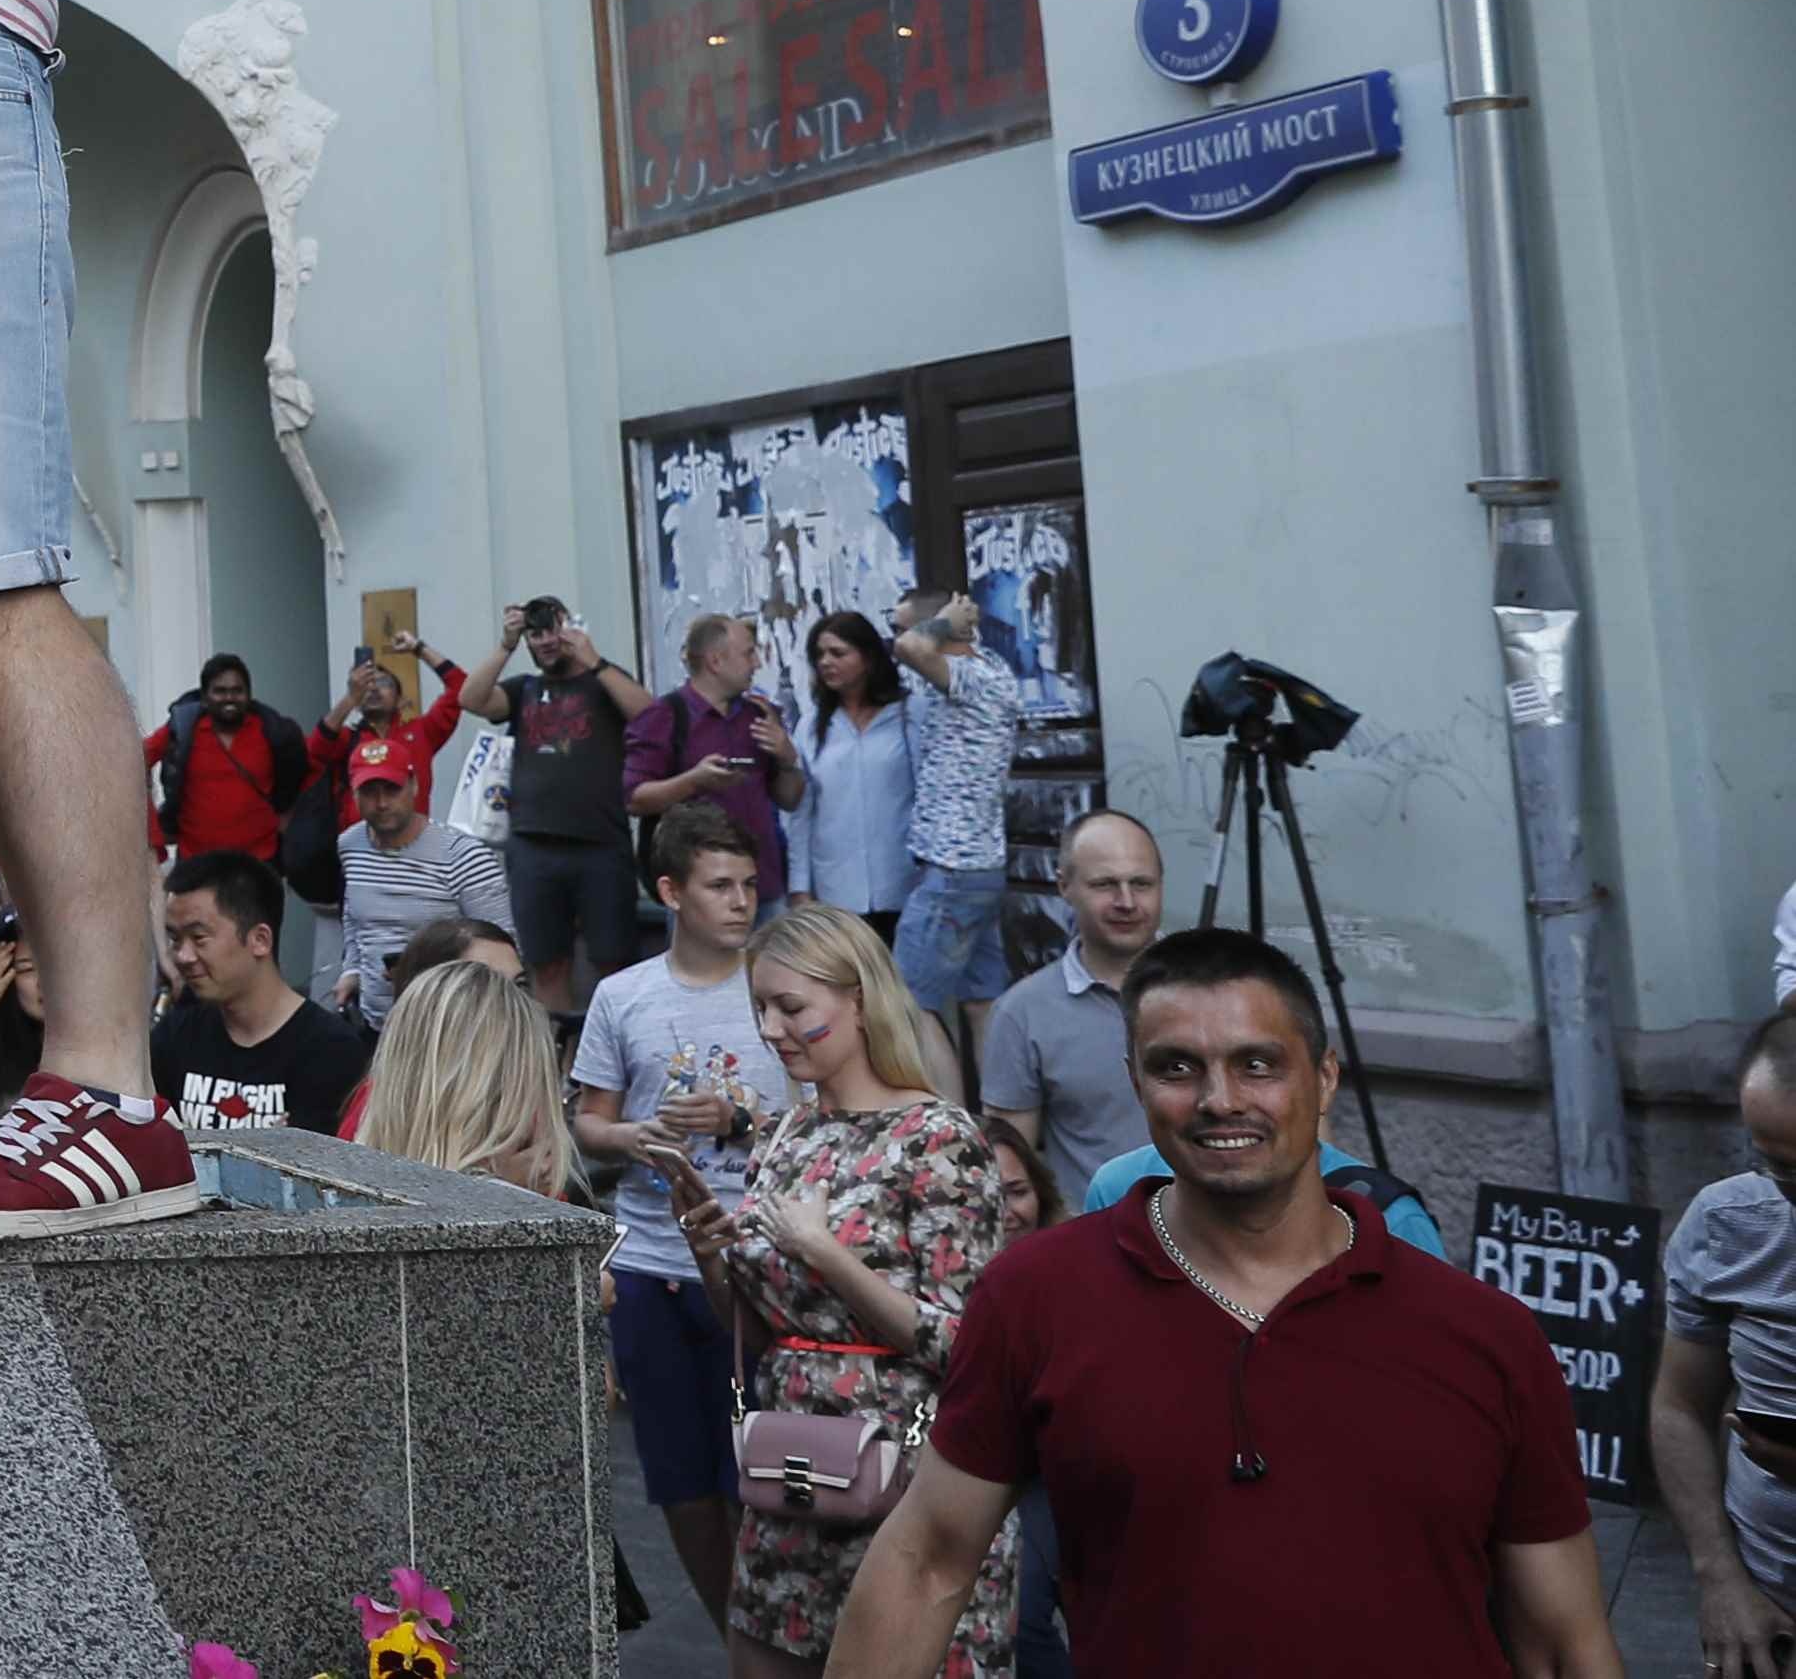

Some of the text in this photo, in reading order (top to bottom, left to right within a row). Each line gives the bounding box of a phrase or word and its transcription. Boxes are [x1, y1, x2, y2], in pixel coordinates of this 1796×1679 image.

[632, 31, 825, 209] SALE
[1098, 105, 1340, 192] КУЗНЕЦКИЙ МОСТ
[1190, 186, 1252, 211] УЛИЦА
[463, 734, 495, 792] VISA
[183, 1072, 213, 1104] IN
[179, 1100, 217, 1129] WE
